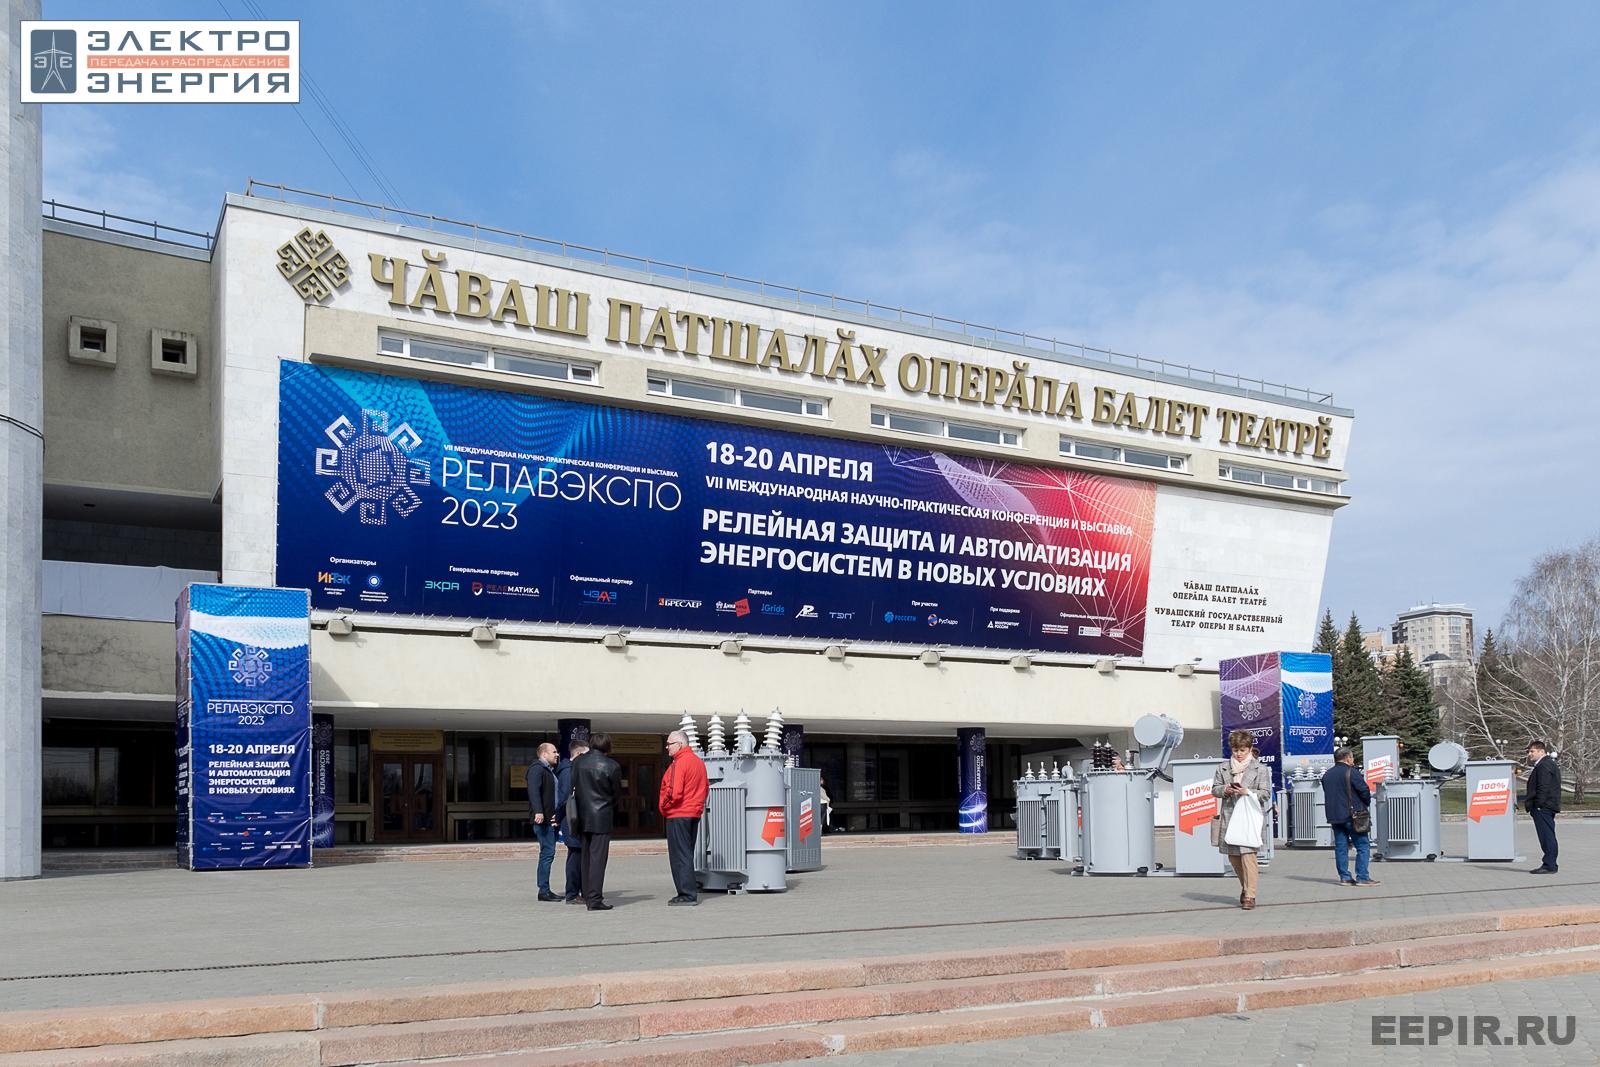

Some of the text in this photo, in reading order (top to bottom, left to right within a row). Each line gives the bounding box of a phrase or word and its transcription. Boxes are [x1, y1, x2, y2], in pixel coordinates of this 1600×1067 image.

[1091, 386, 1210, 440] БАЛЕТ
[444, 444, 454, 452] VII
[454, 445, 517, 460] МЕЖДУНАРОДНАЯ
[517, 452, 595, 469] НАУЧНО-ПРАКТИЧЕСКАЯ
[595, 461, 641, 474] КОНФЕРЕНЦИЯ
[647, 467, 679, 478] ВЫСТАВКА
[705, 441, 873, 482] 18-20 АПРЕЛЯ
[442, 456, 682, 511] РЕЛАВЭКСПО
[705, 475, 1133, 537] VII МЕЖДУНАРОДНАЯ НАУЧНО-ПРАКТИЧЕСКАЯ КОНФЕРЕНЦИЯ И ВЫСТАВКА
[441, 496, 518, 531] 2023
[702, 508, 1132, 573] РЕЛЕЙНАЯ ЗАЩИТА И АВТОМАТИЗАЦИЯ
[330, 556, 377, 566] Организаторы
[700, 541, 1106, 597] ЭНЕРГОСИСТЕМ В НОВЫХ УСЛОВИЯХ
[1212, 594, 1237, 604] БАЛЕТ
[1155, 607, 1283, 623] ЧУВАШСКИЙ ГОСУДАРСТВЕННЫЙ
[1171, 619, 1196, 628] ТЕАТР
[1199, 621, 1226, 630] ОПЕРЫ
[1236, 624, 1264, 633] БАЛЕТА
[207, 703, 294, 714] РЕЛАВЭКСПО
[238, 716, 264, 725] 2023
[209, 744, 296, 755] 18-20 АПРЕЛЯ
[208, 760, 290, 769] РЕЛЕЙНАЯ ЗАЩИТА
[217, 769, 291, 778] АВТОМАТИЗАЦИЯ
[208, 778, 276, 786] ЭНЕРГОСИСТЕМ
[1480, 782, 1506, 790] 100%
[216, 786, 249, 795] НОВЫХ
[250, 786, 296, 794] УСЛОВИЯХ
[1185, 784, 1211, 797] 100%
